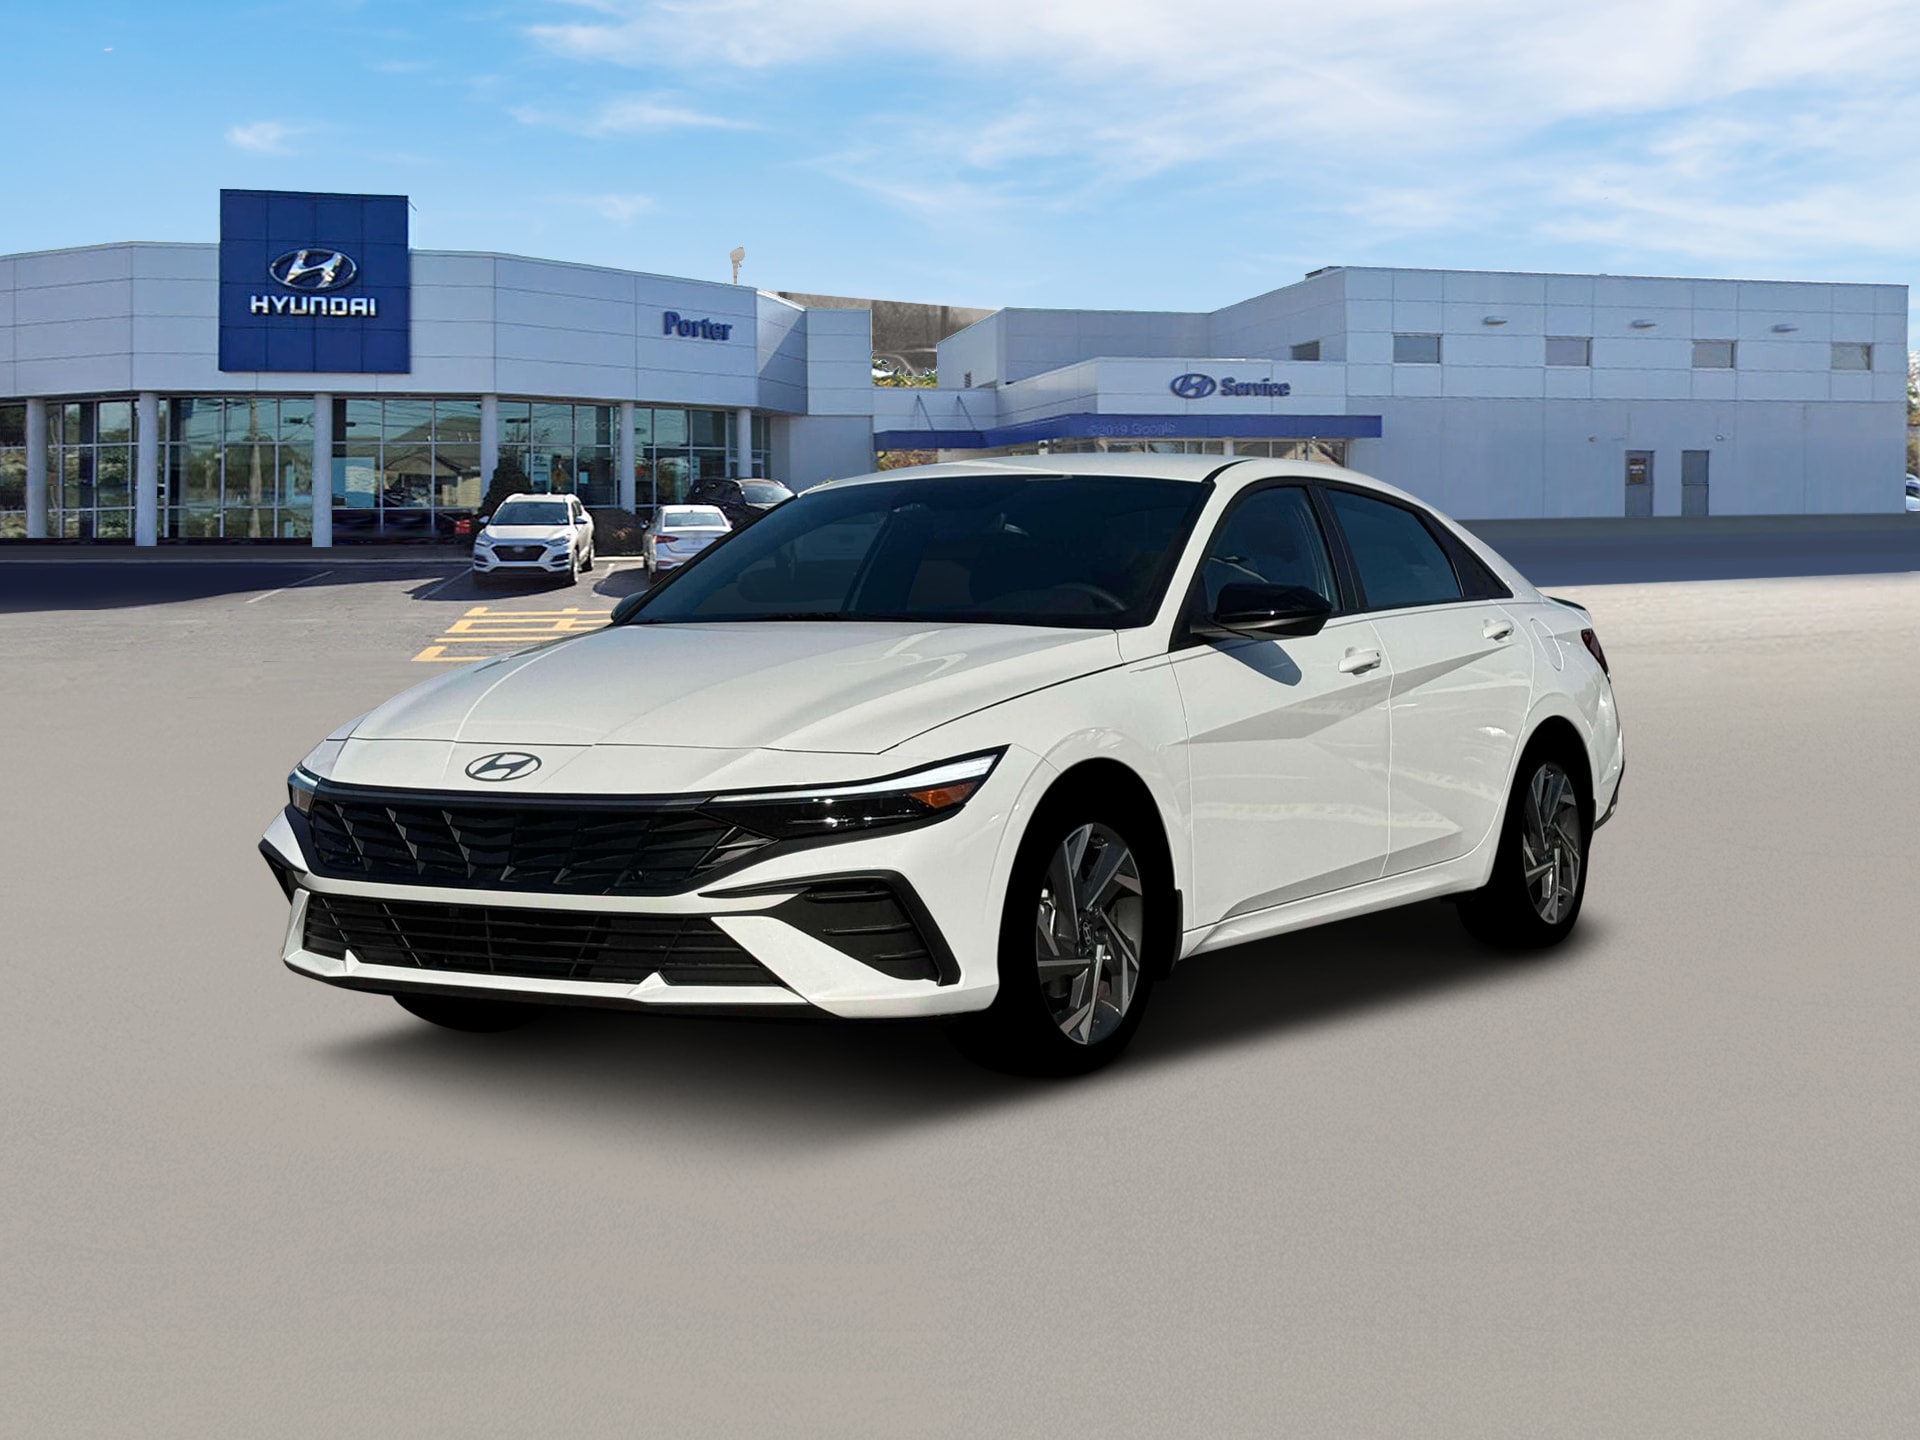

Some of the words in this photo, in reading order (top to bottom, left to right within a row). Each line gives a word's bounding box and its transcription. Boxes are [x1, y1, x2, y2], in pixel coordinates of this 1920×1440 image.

[250, 295, 376, 316] HYUNDAI
[663, 311, 733, 341] Porter
[1220, 377, 1291, 397] Service
